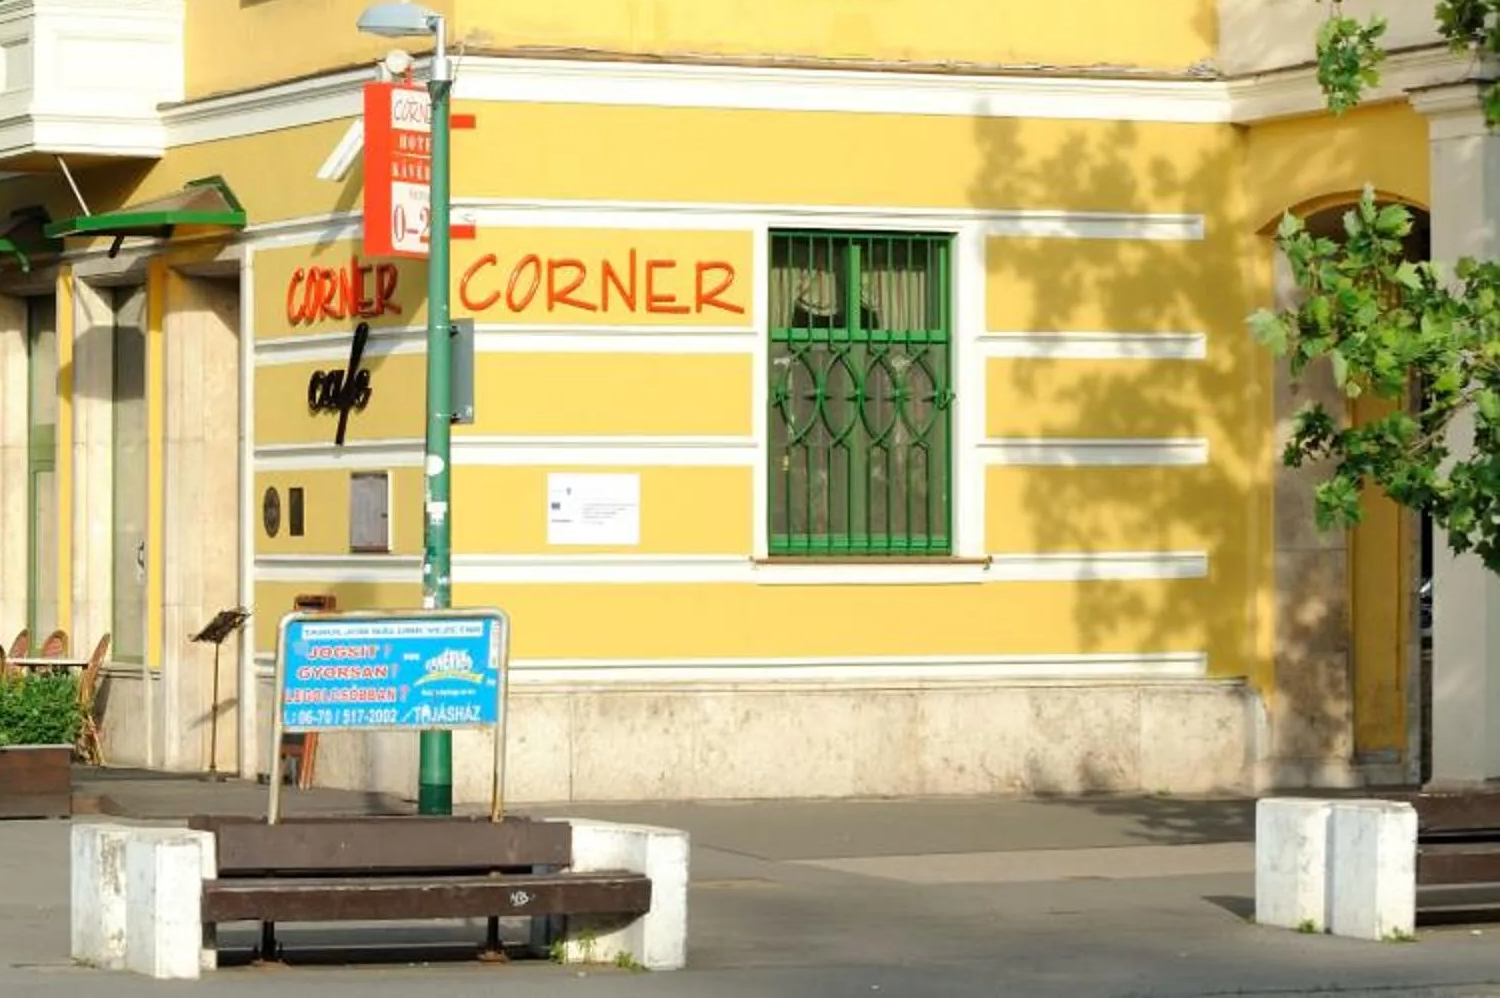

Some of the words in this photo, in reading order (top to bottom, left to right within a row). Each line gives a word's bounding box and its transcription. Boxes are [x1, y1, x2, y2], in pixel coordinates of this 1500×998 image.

[287, 254, 403, 326] CORNER
[458, 247, 745, 316] CORNER
[296, 664, 389, 681] GYORSAN
